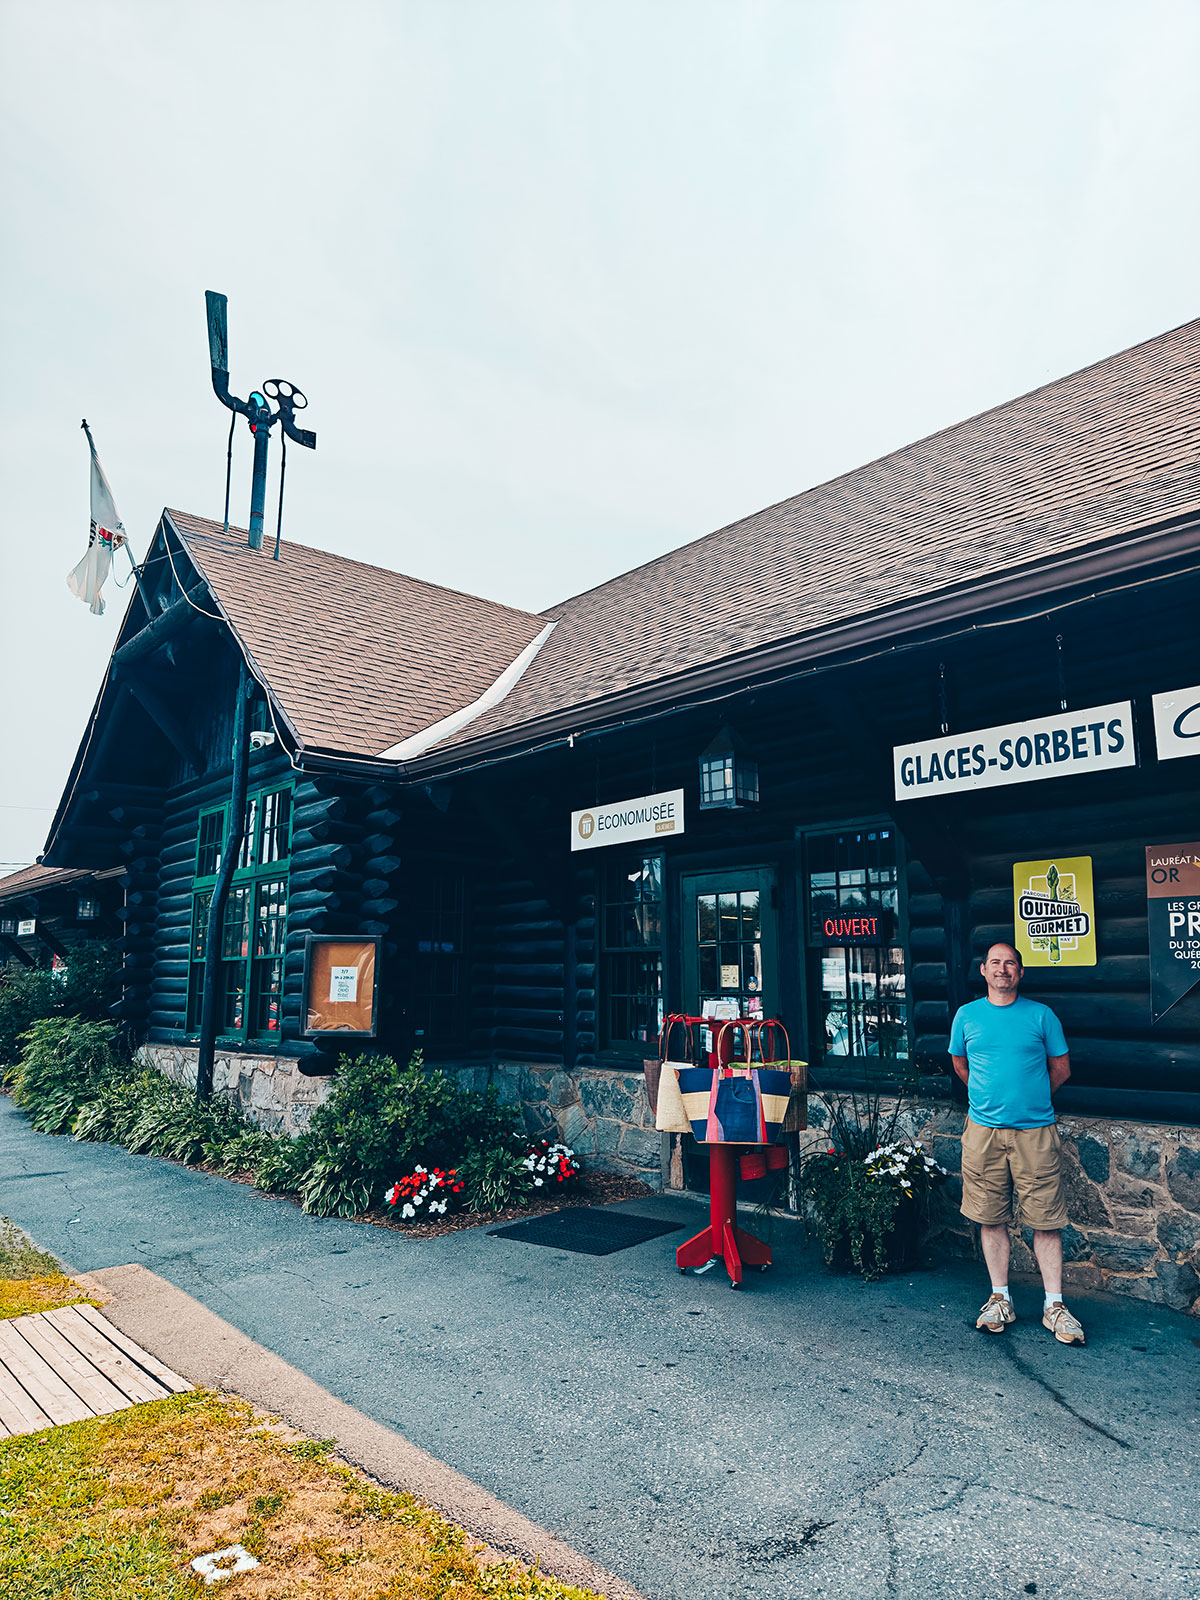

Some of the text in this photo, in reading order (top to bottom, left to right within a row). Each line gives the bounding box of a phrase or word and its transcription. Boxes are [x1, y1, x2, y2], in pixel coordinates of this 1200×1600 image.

[901, 719, 1125, 786] GLACES-SORBETS
[598, 802, 675, 831] ÉCONOMUSÉE
[1151, 855, 1191, 867] LAURÉAT
[1151, 867, 1180, 884] OR
[1024, 901, 1079, 916] OUTAOUAIS
[1167, 902, 1185, 911] LES
[824, 918, 878, 936] OUVERT
[1030, 918, 1082, 934] GOURMET
[1169, 941, 1184, 949] DU
